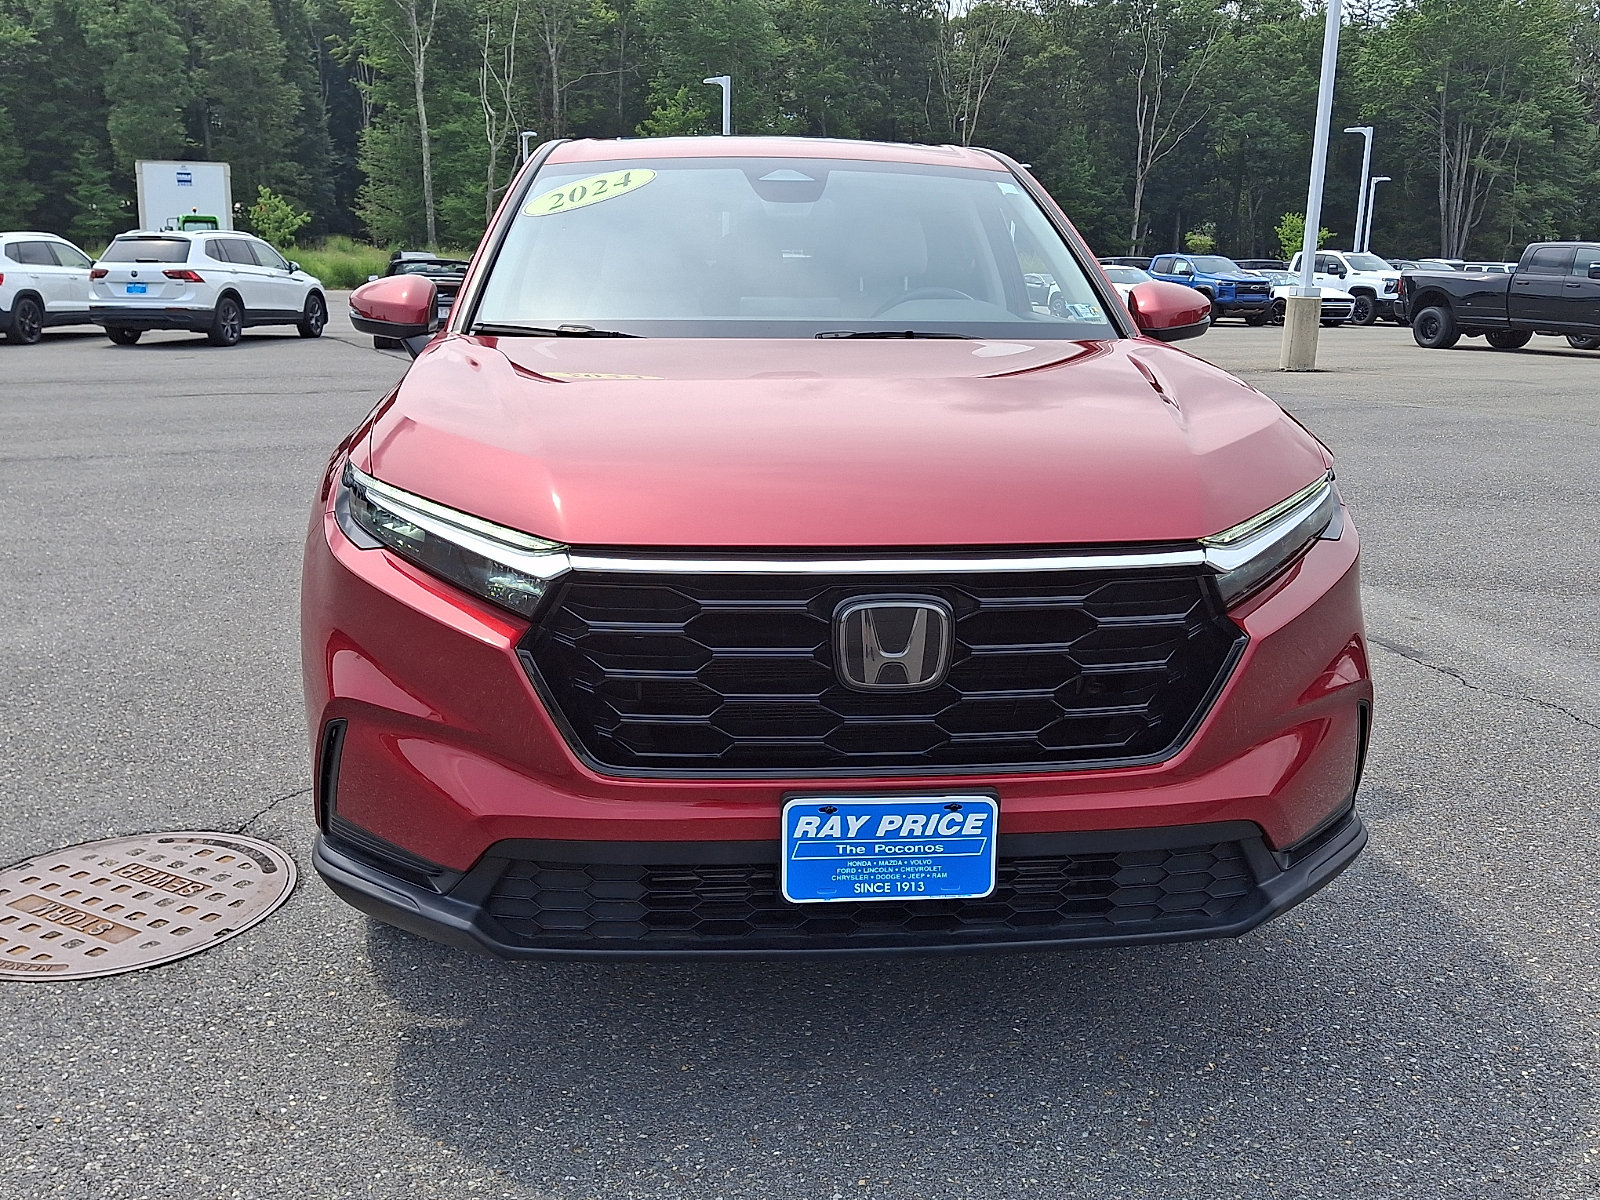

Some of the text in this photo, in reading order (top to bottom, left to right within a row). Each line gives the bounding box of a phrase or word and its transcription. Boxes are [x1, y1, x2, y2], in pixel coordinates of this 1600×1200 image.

[549, 172, 632, 211] 2024
[793, 813, 988, 838] RAY PRICE
[836, 843, 944, 855] The Poconos
[118, 863, 206, 897] SEWER
[900, 865, 942, 873] CHEVROLET
[853, 881, 925, 894] SINCE 1913
[27, 901, 115, 935] STORM
